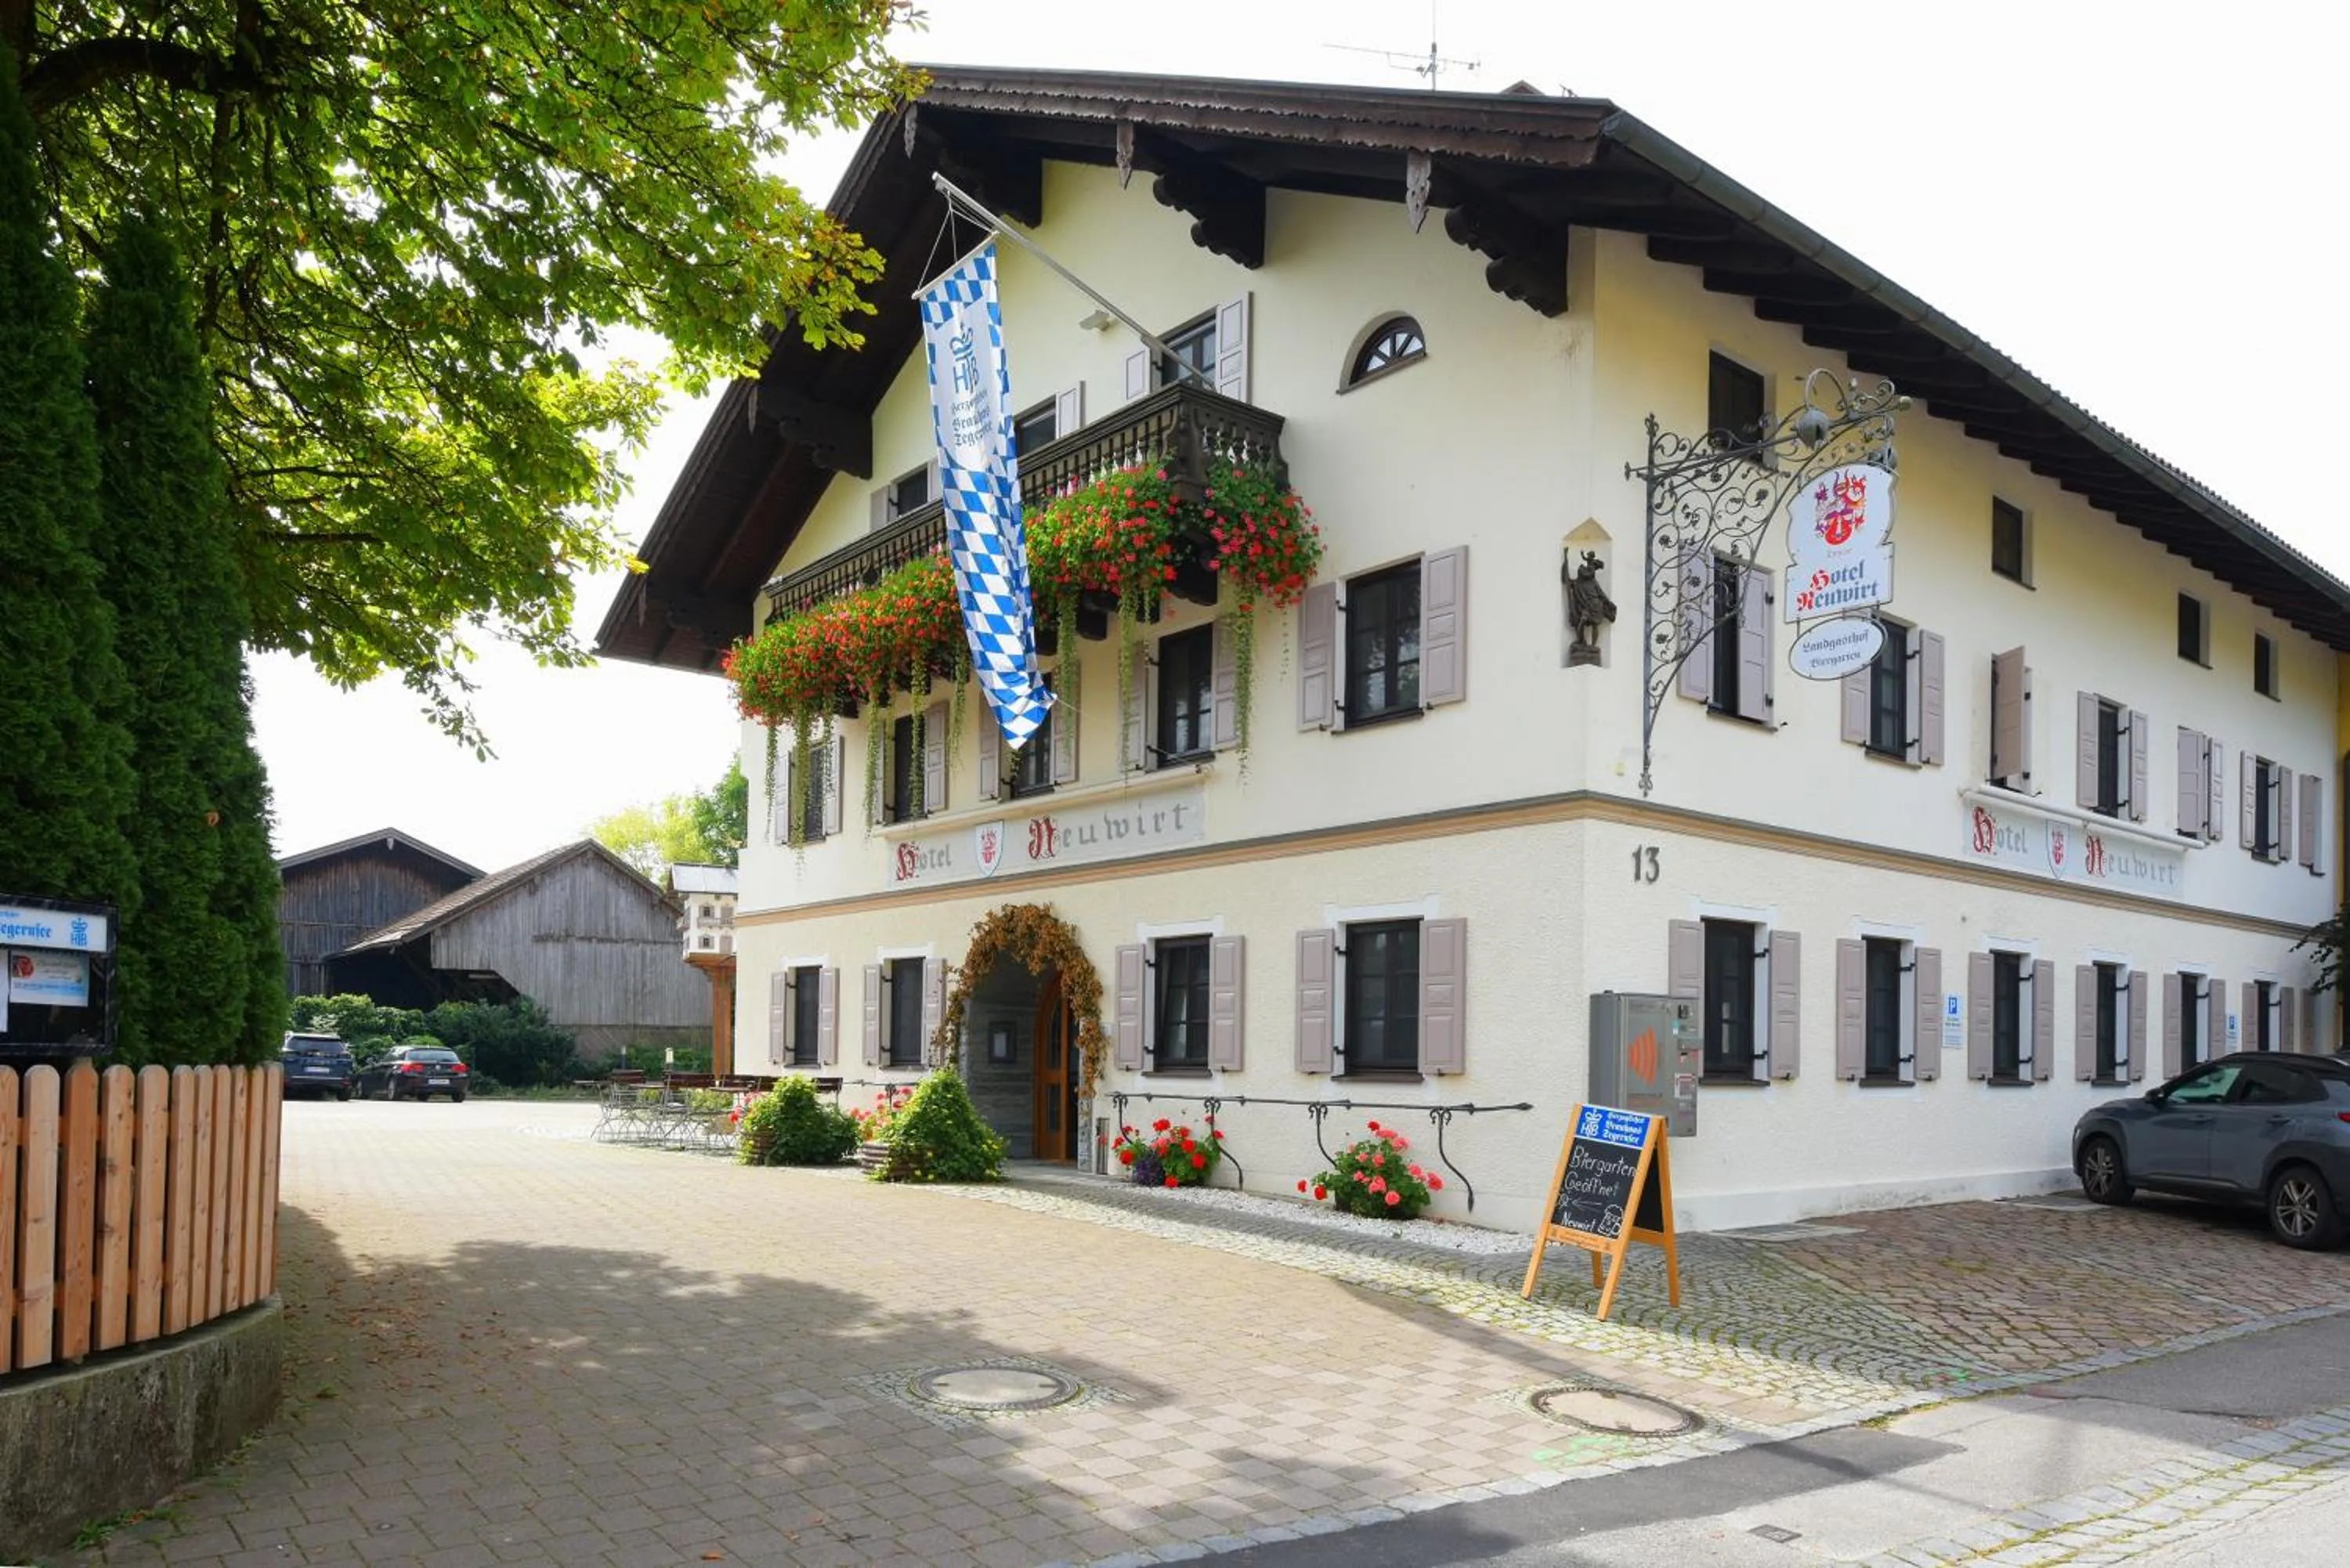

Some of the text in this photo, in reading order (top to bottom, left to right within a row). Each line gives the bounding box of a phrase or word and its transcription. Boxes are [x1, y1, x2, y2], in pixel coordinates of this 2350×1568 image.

[1810, 559, 1864, 591] Hotel
[1796, 581, 1880, 612] Neuwirt
[895, 802, 1188, 881] Hotel Neuwirt
[1972, 804, 2176, 884] Hotel Neuwirt
[1632, 844, 1661, 883] 13
[1569, 1144, 1636, 1176] Biergarten
